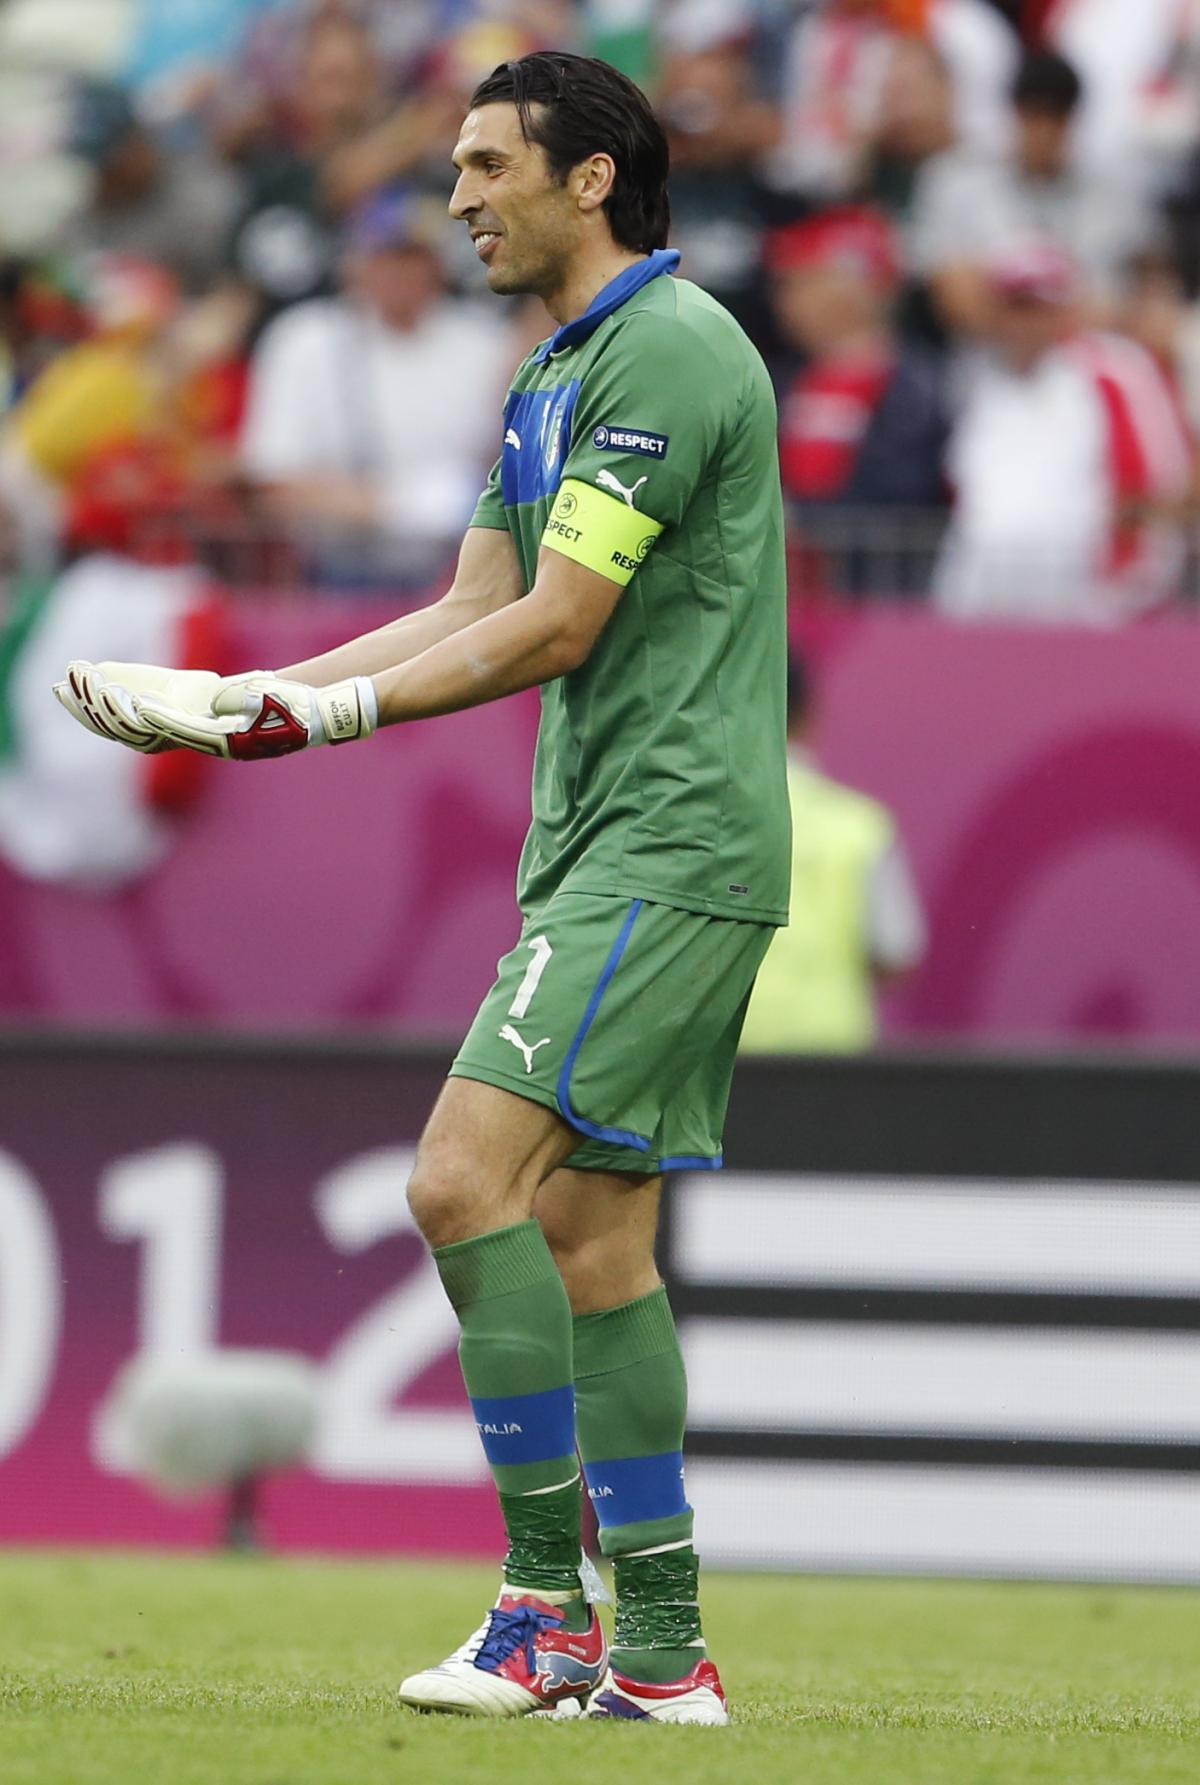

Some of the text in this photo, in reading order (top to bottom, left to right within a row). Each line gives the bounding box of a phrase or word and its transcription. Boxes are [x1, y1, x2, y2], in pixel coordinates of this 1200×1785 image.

[610, 432, 665, 453] RESPECT
[546, 519, 583, 542] SPECT
[507, 935, 553, 1019] 1
[475, 1422, 523, 1434] TALIA
